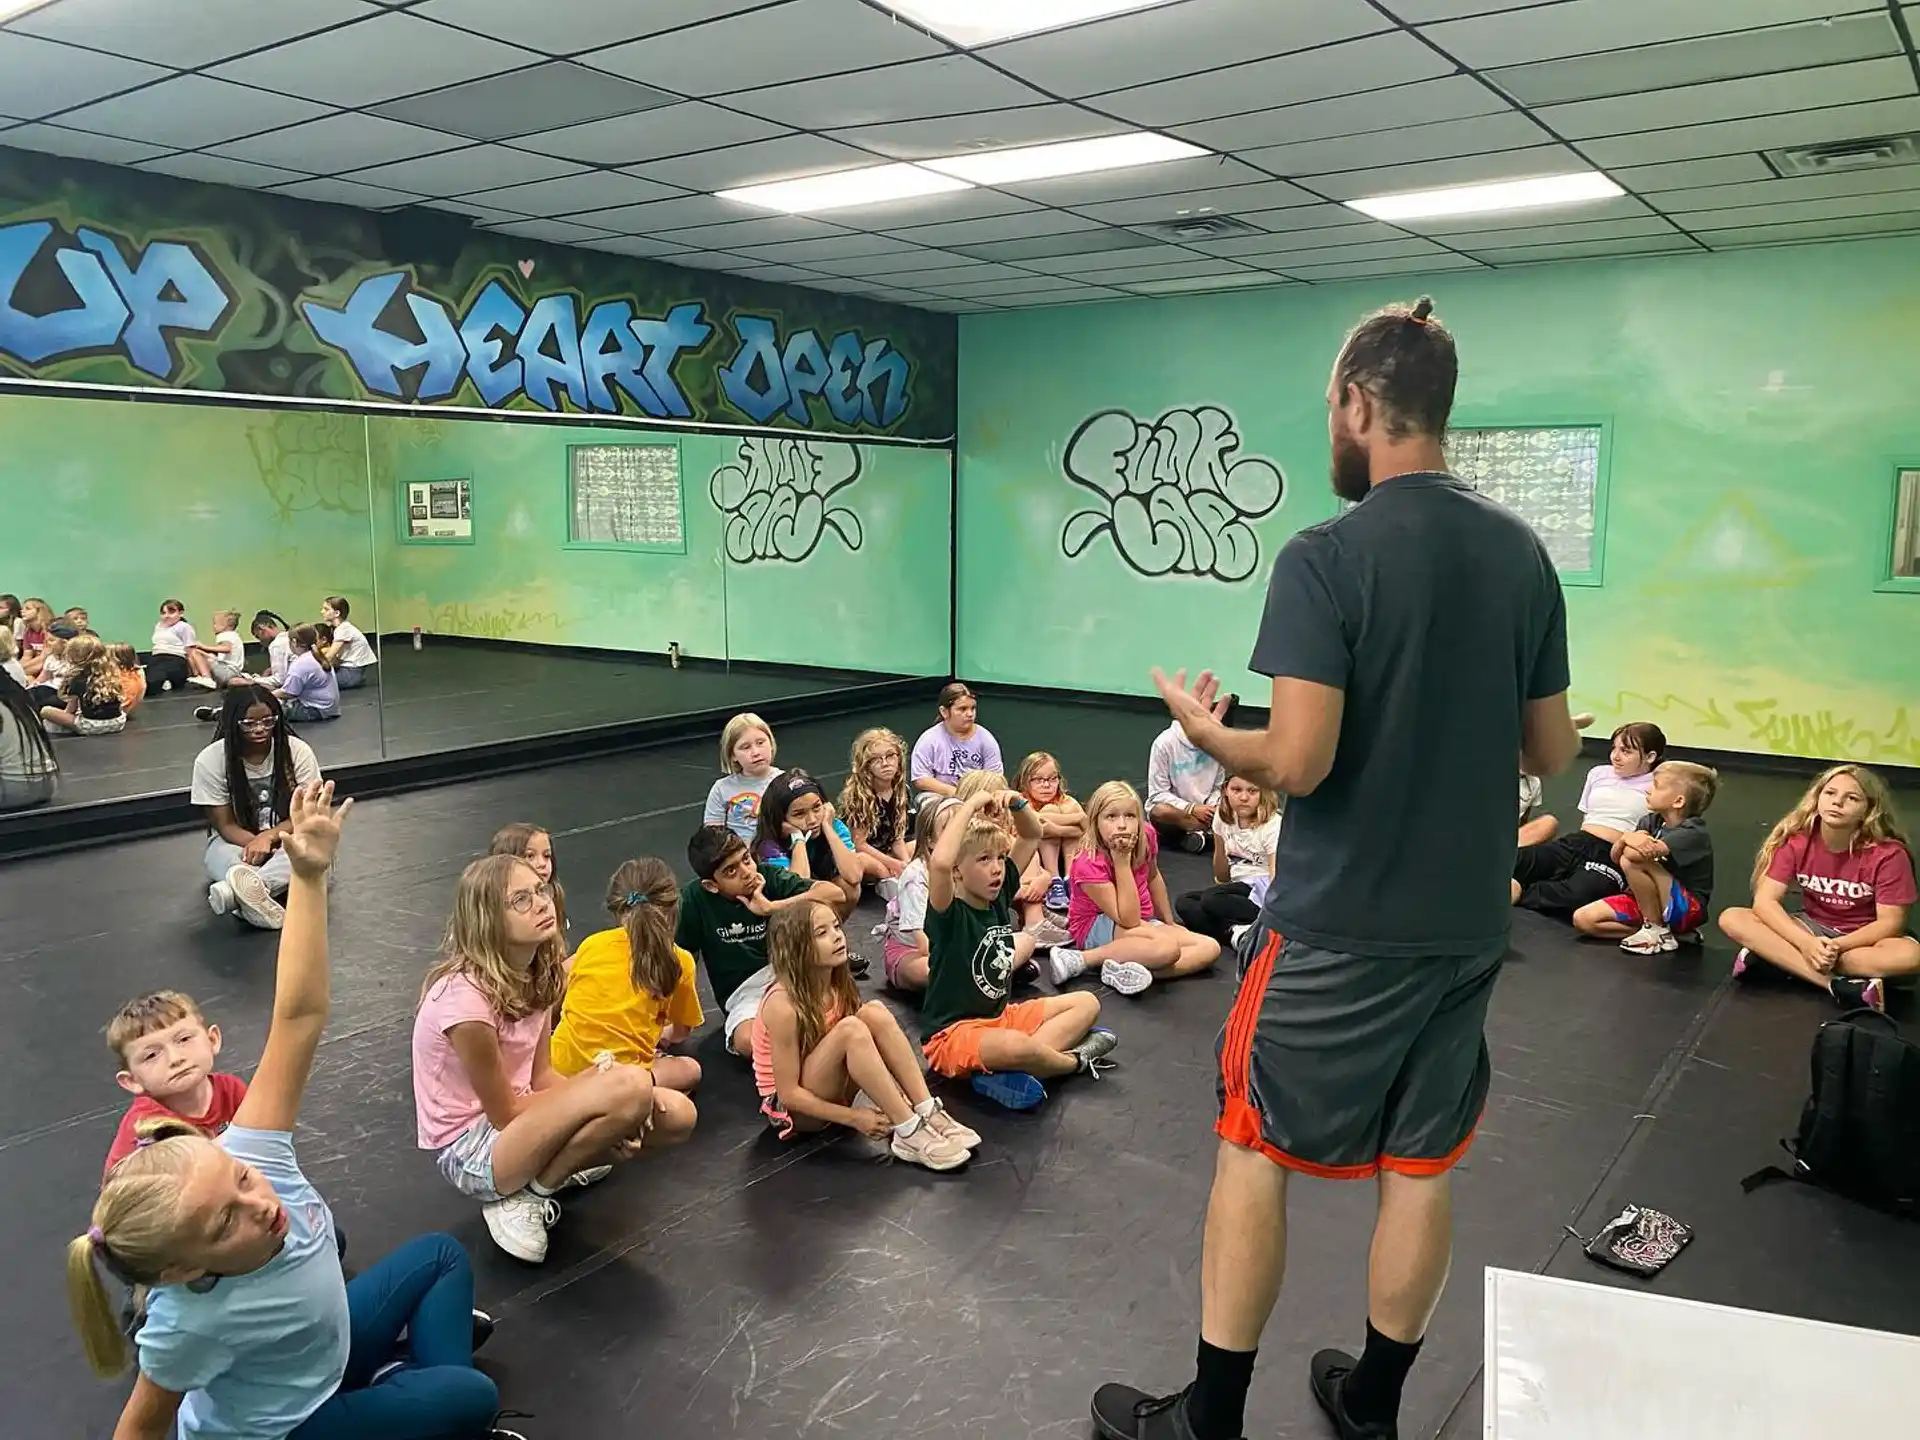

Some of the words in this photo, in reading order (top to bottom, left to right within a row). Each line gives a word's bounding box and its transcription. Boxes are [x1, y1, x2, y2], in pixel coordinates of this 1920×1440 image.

[0, 220, 230, 379] UP
[301, 271, 714, 419] HEART
[719, 315, 909, 426] OPEN
[1062, 405, 1285, 519] FUNK
